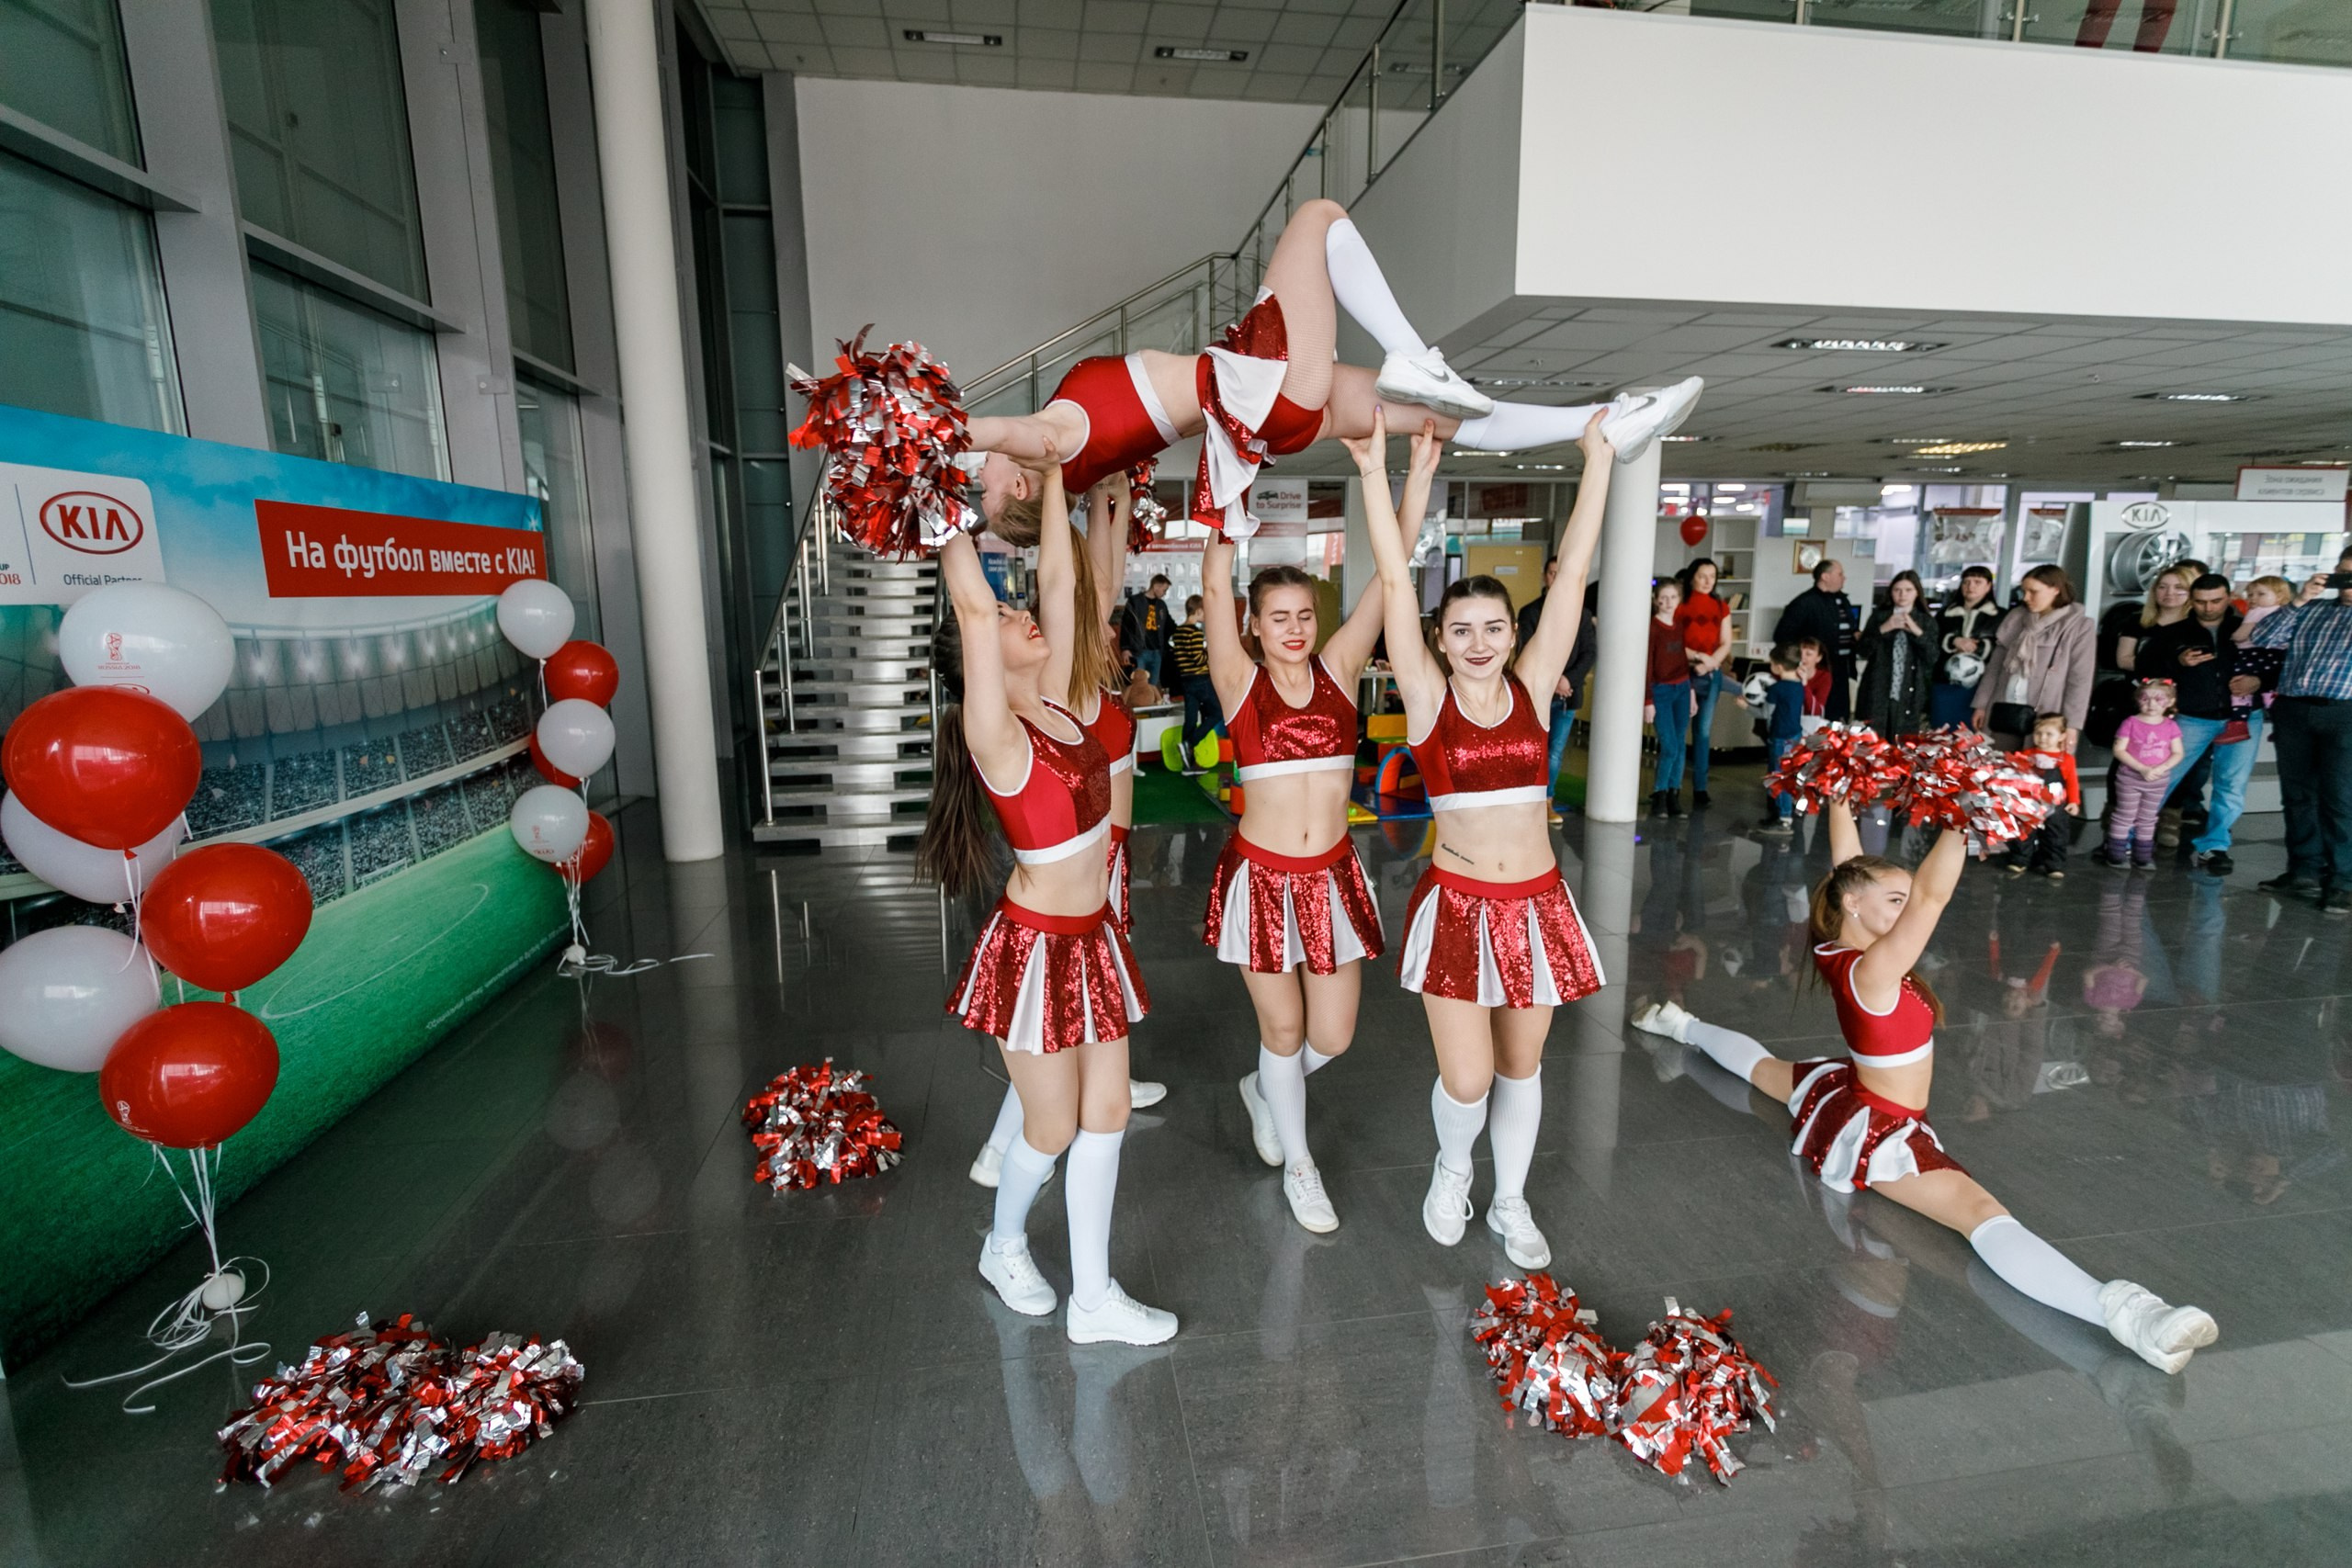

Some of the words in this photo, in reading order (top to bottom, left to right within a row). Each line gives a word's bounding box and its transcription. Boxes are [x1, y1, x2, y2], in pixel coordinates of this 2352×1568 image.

[1280, 491, 1302, 500] Drive
[1267, 501, 1302, 510] Surprise
[2132, 509, 2161, 522] KIA
[55, 503, 130, 542] KIA
[285, 530, 326, 569] На
[334, 534, 425, 579] футбол
[429, 549, 492, 574] вместе
[495, 552, 504, 574] с
[506, 547, 537, 575] KIA!
[63, 574, 102, 586] Official
